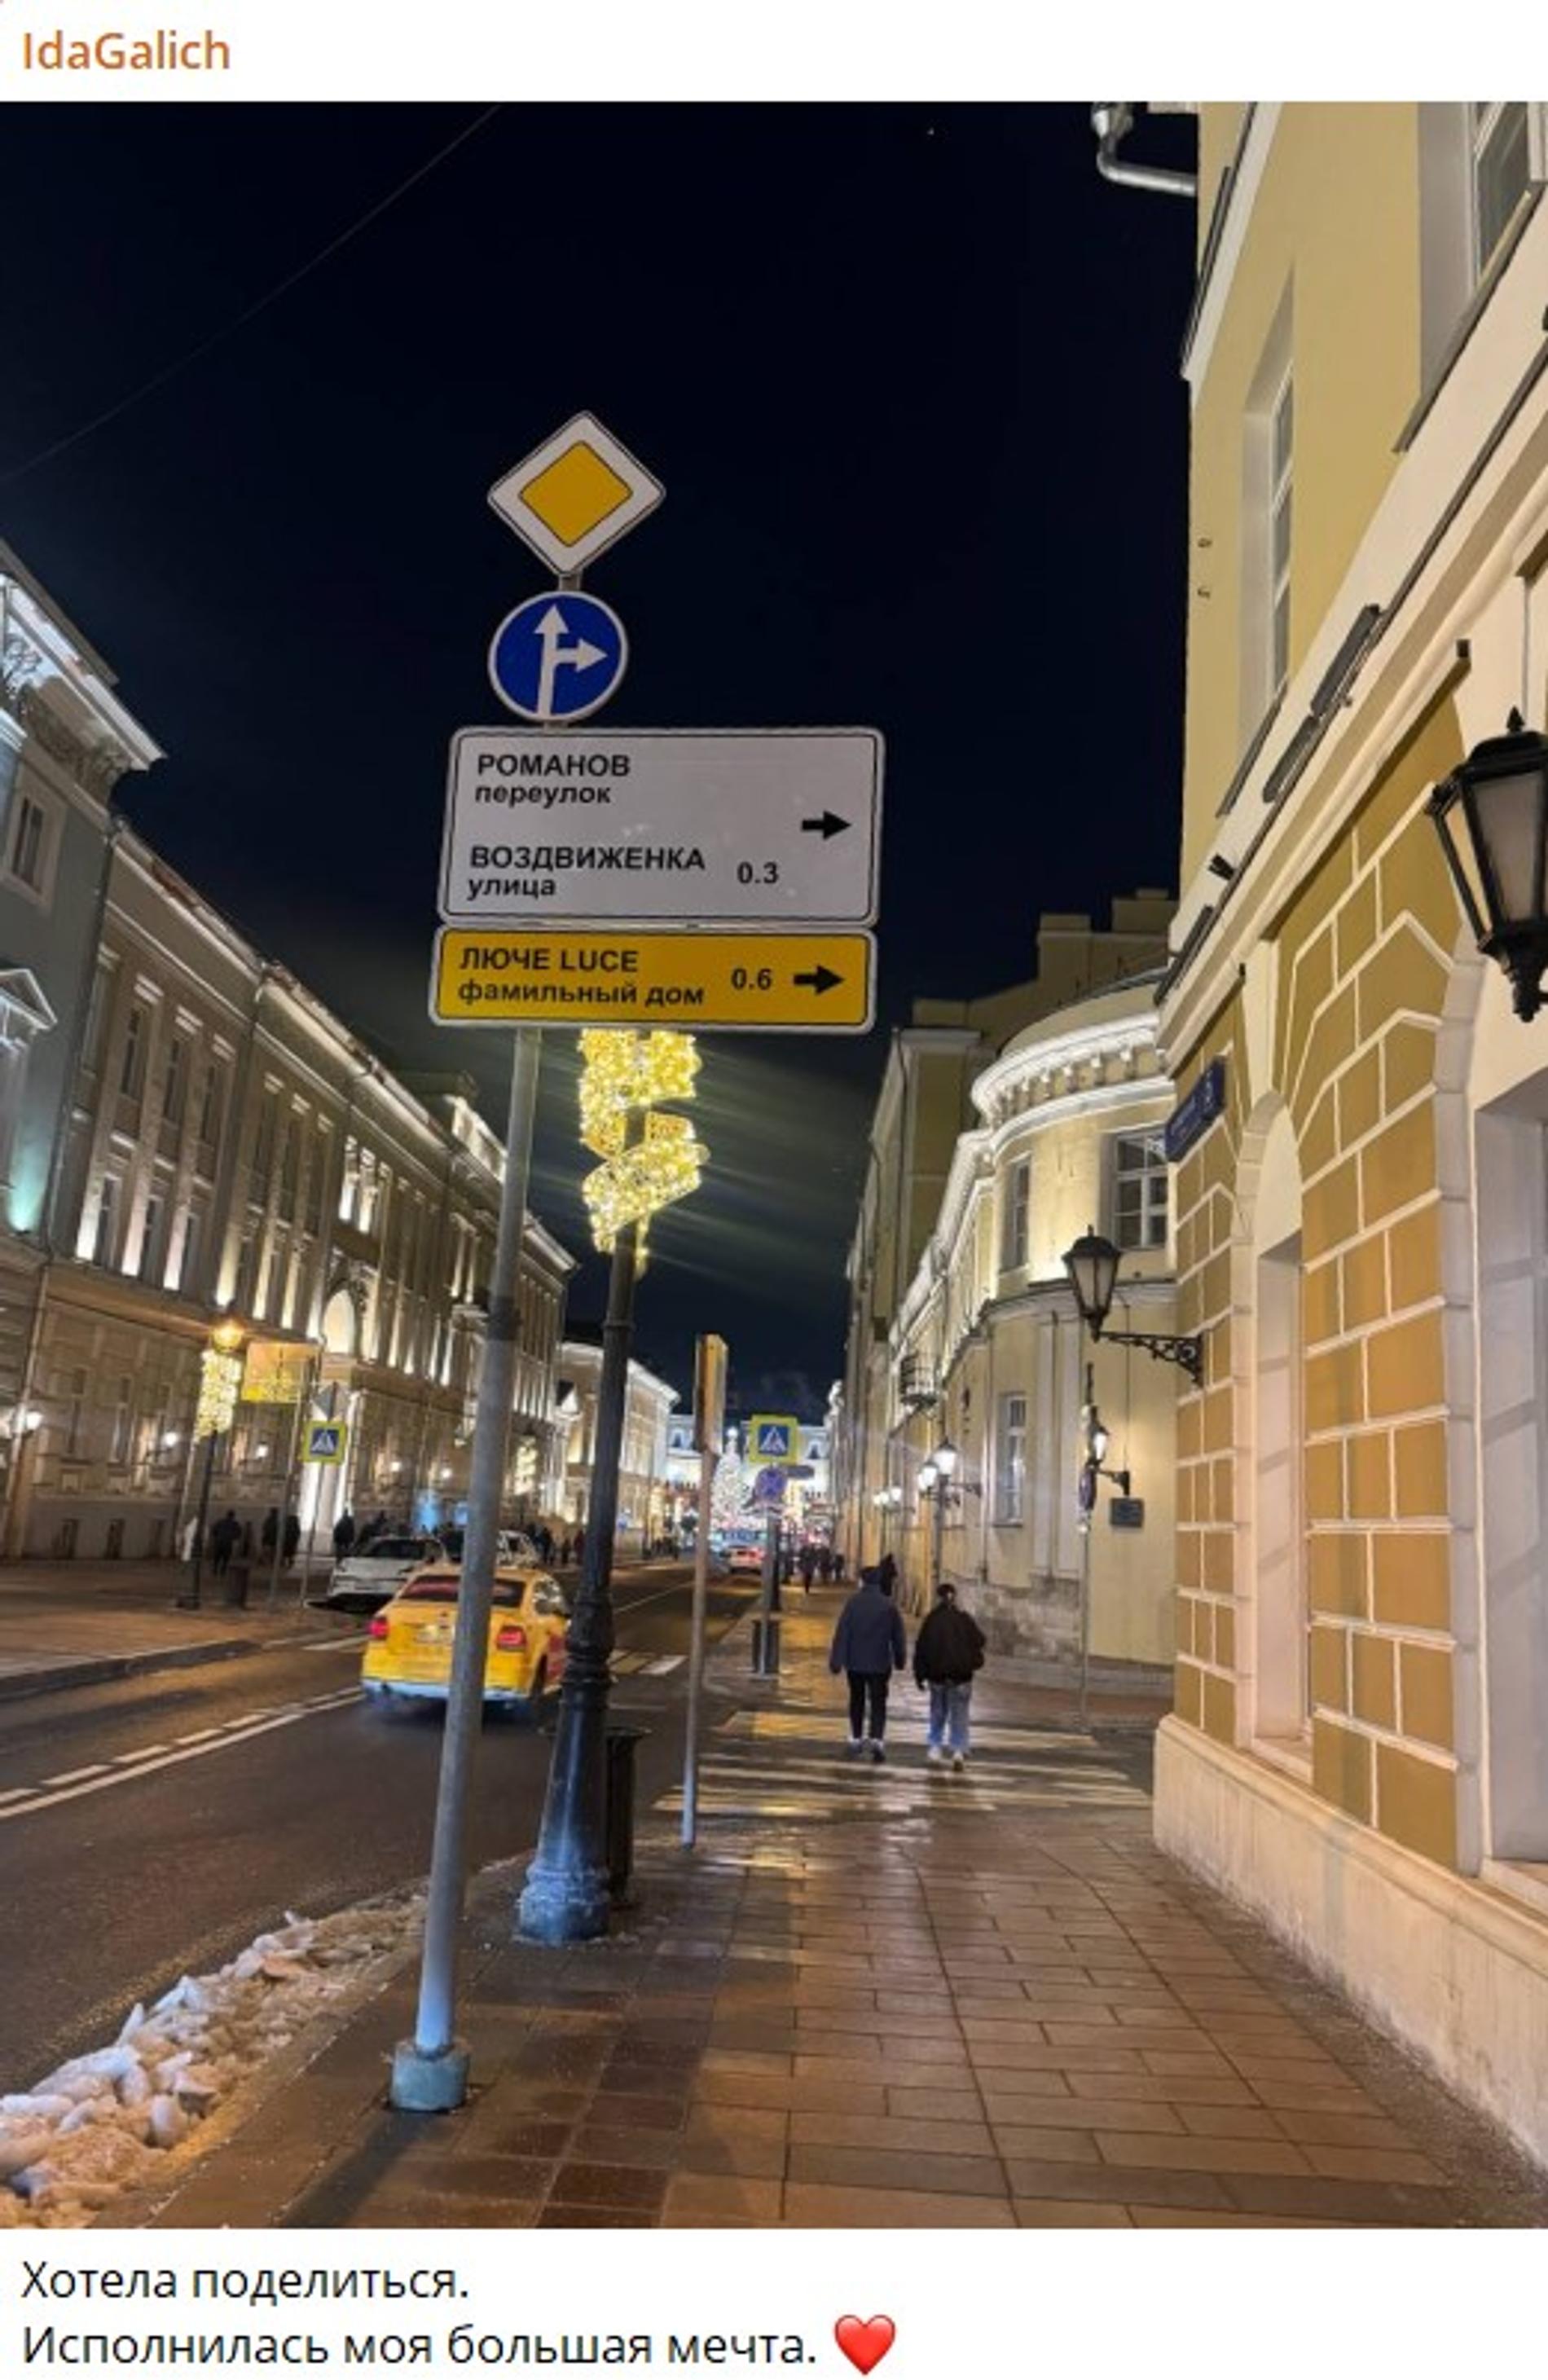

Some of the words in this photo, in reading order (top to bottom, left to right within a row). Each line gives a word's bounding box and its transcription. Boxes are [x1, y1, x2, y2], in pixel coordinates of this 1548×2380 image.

[477, 754, 631, 777] РОМАНОВ
[475, 785, 610, 808] переулок
[470, 846, 706, 871] ВОЗДВИЖЕНКА
[737, 861, 780, 885] 0.3
[467, 878, 556, 900] улица
[460, 948, 551, 971] ЛЮЧЕ
[561, 949, 639, 973] LUCE
[730, 967, 772, 990] 0.6
[458, 978, 637, 1005] фамильный
[644, 986, 704, 1007] дом
